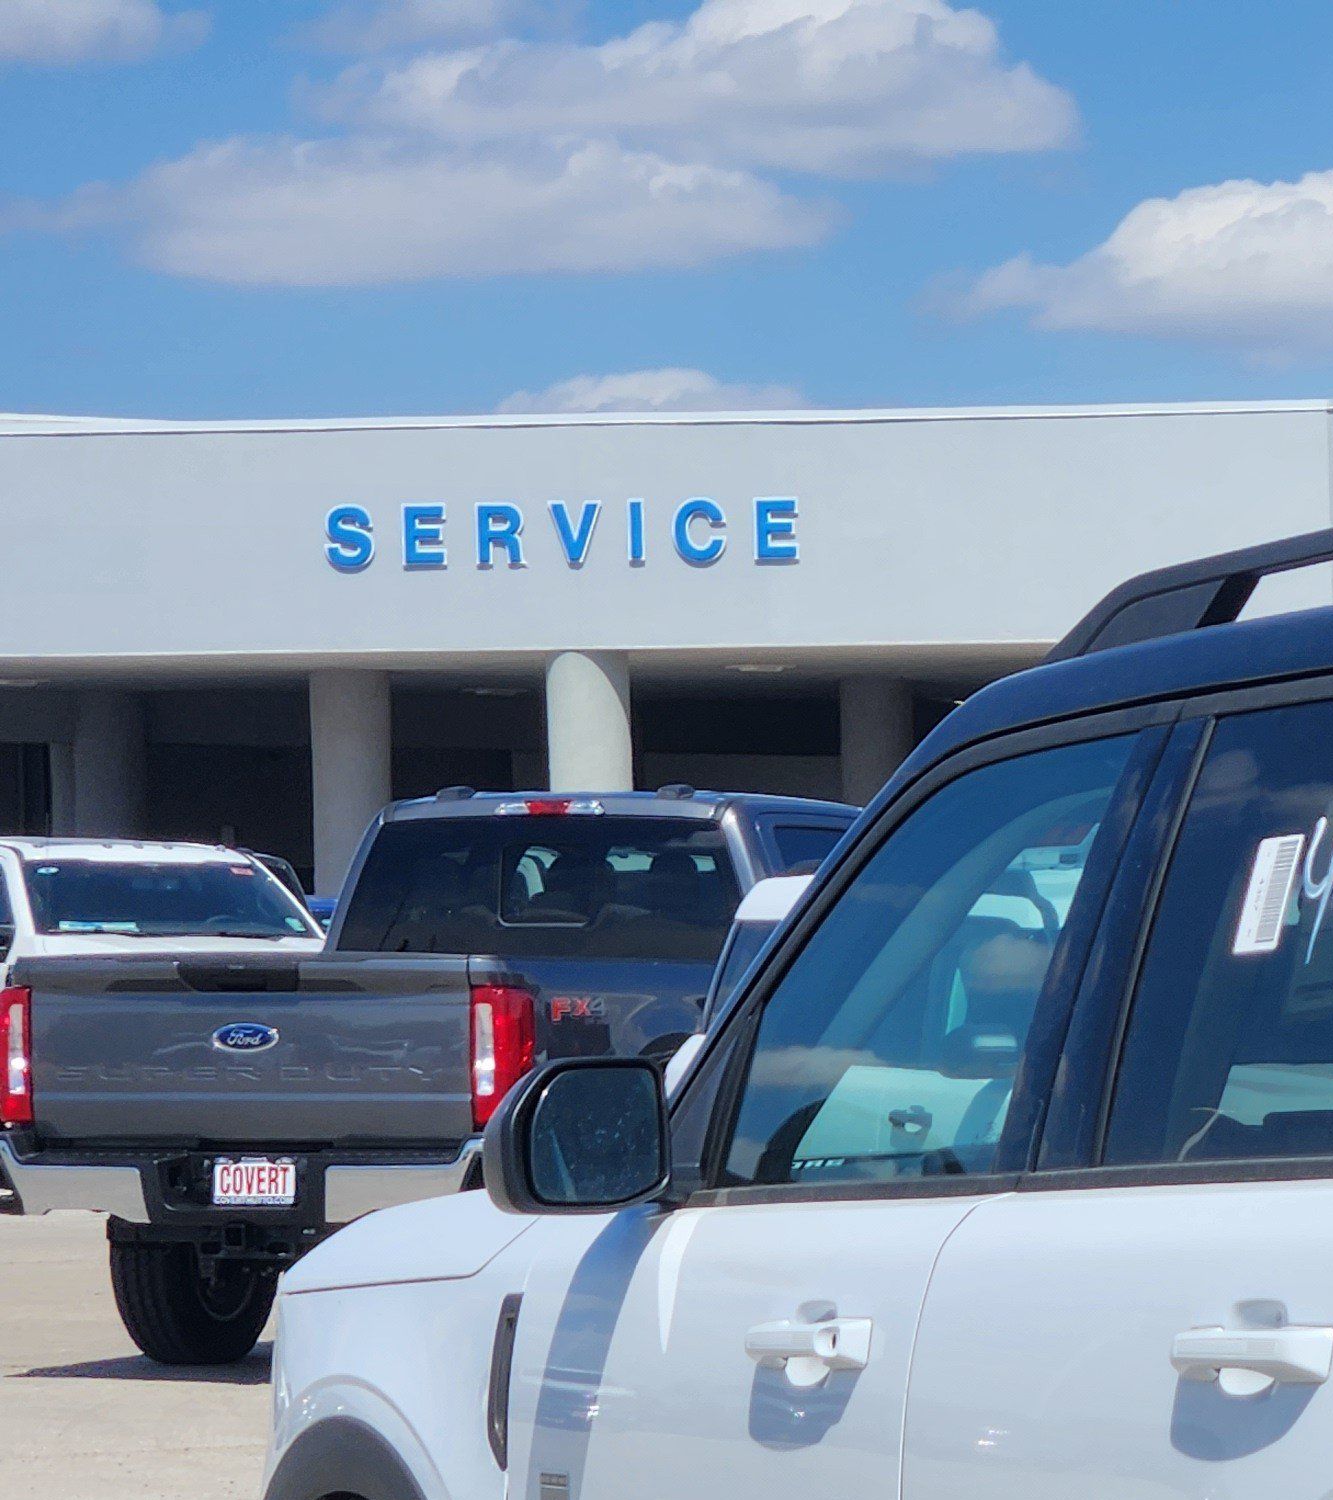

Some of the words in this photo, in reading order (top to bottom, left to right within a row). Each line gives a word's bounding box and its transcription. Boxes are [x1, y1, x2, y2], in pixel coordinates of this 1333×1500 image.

[325, 497, 799, 569] SERVICE
[550, 996, 607, 1021] FX4
[220, 1166, 289, 1195] COVERT
